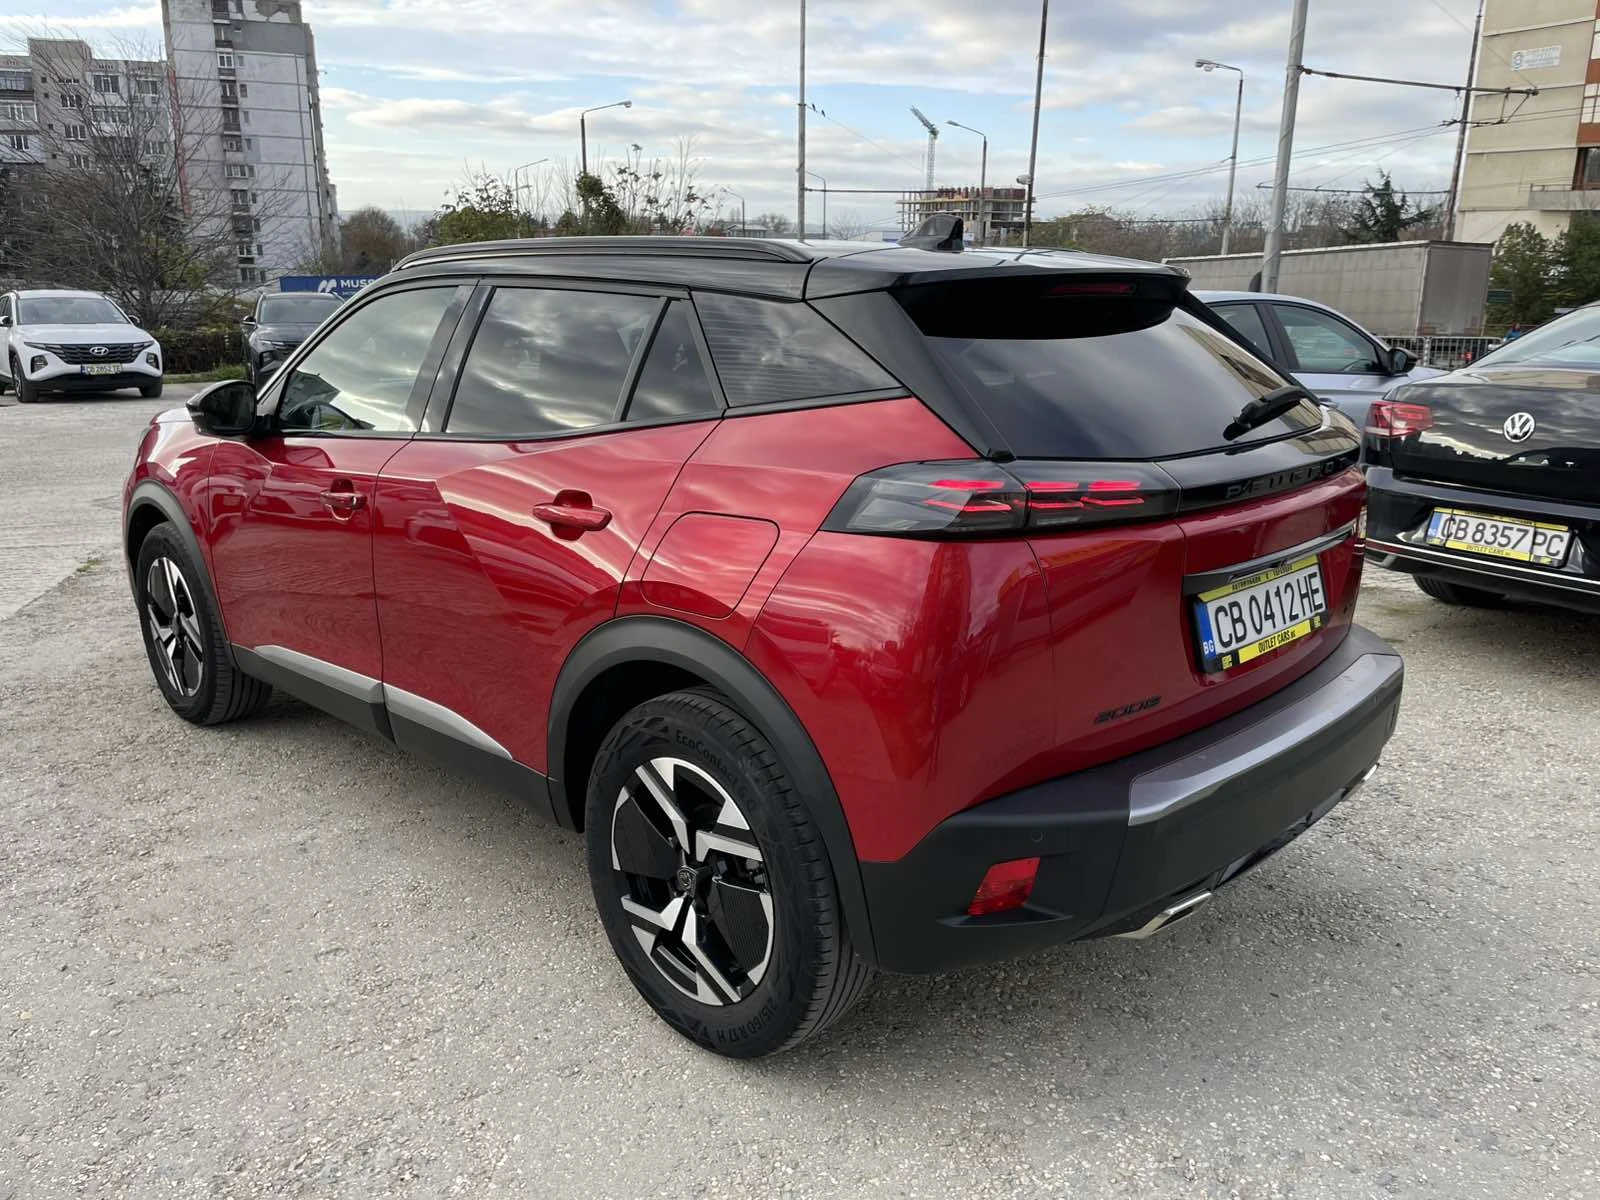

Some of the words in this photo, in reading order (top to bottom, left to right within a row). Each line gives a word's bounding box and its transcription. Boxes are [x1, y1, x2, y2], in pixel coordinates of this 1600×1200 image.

[1472, 522, 1529, 549] 8357
[1249, 582, 1299, 635] 0412
[1203, 639, 1215, 655] BG
